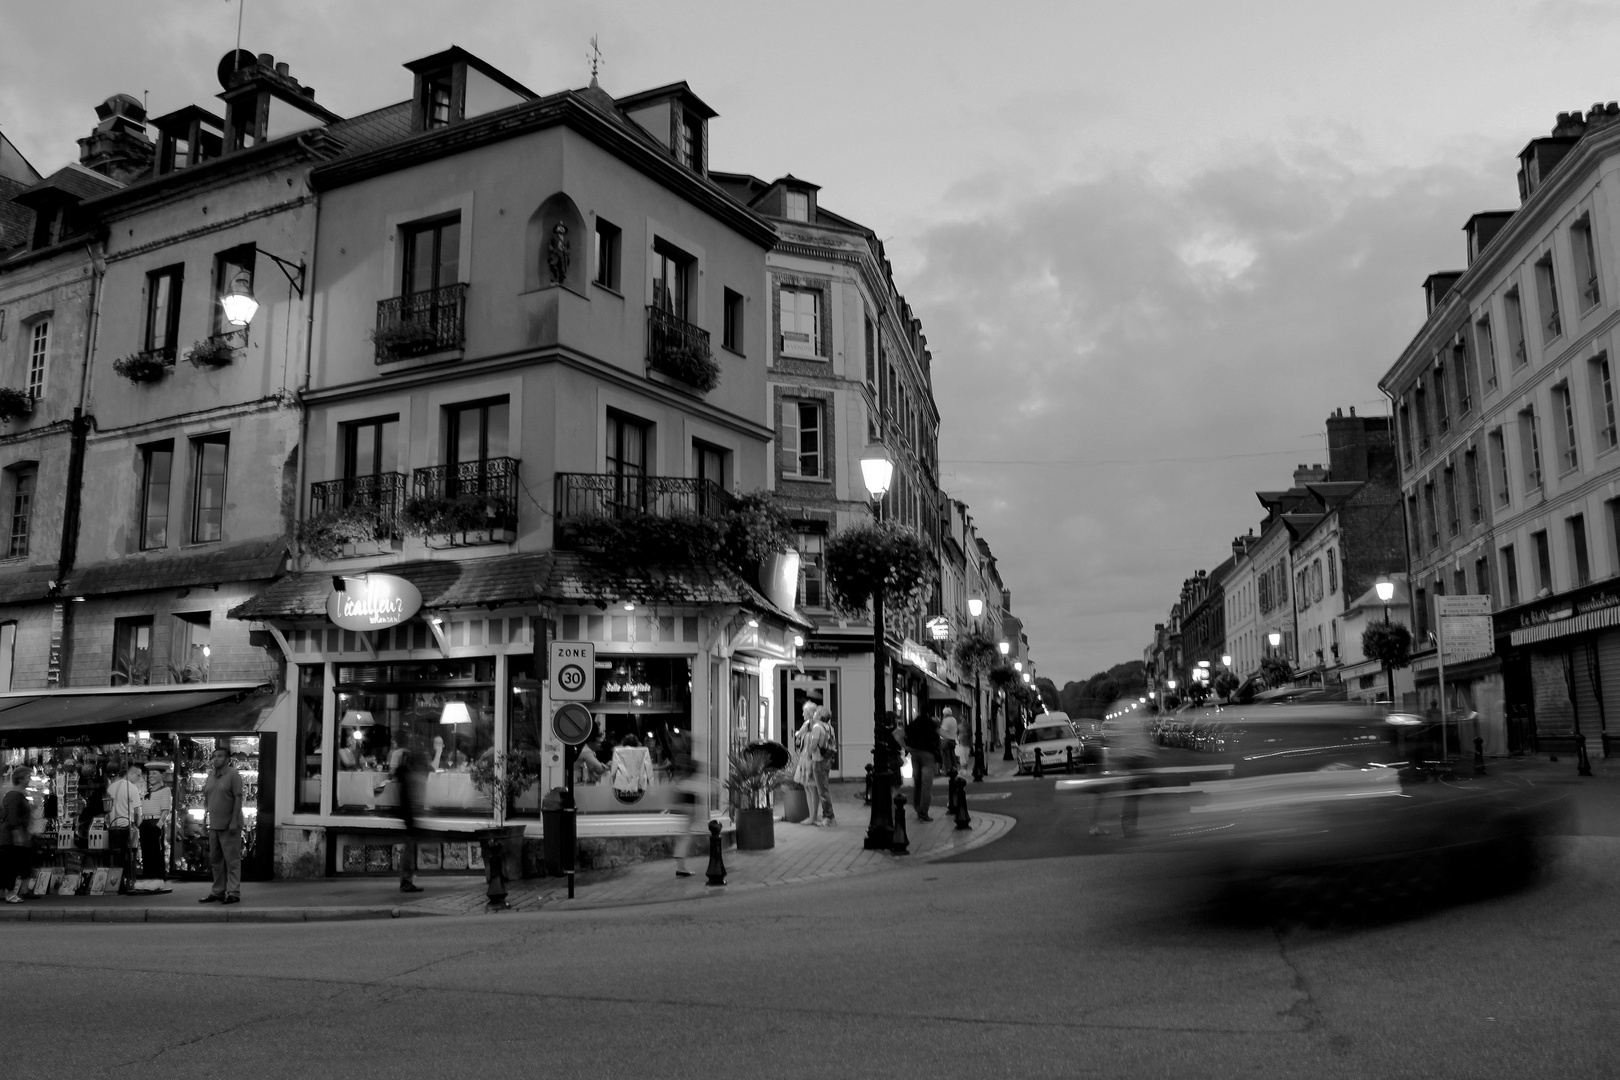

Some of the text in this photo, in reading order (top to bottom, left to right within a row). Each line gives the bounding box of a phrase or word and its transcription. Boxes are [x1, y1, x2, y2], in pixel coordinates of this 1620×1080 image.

[558, 648, 587, 658] ZONE
[564, 672, 580, 684] 30
[606, 681, 621, 692] Salle
